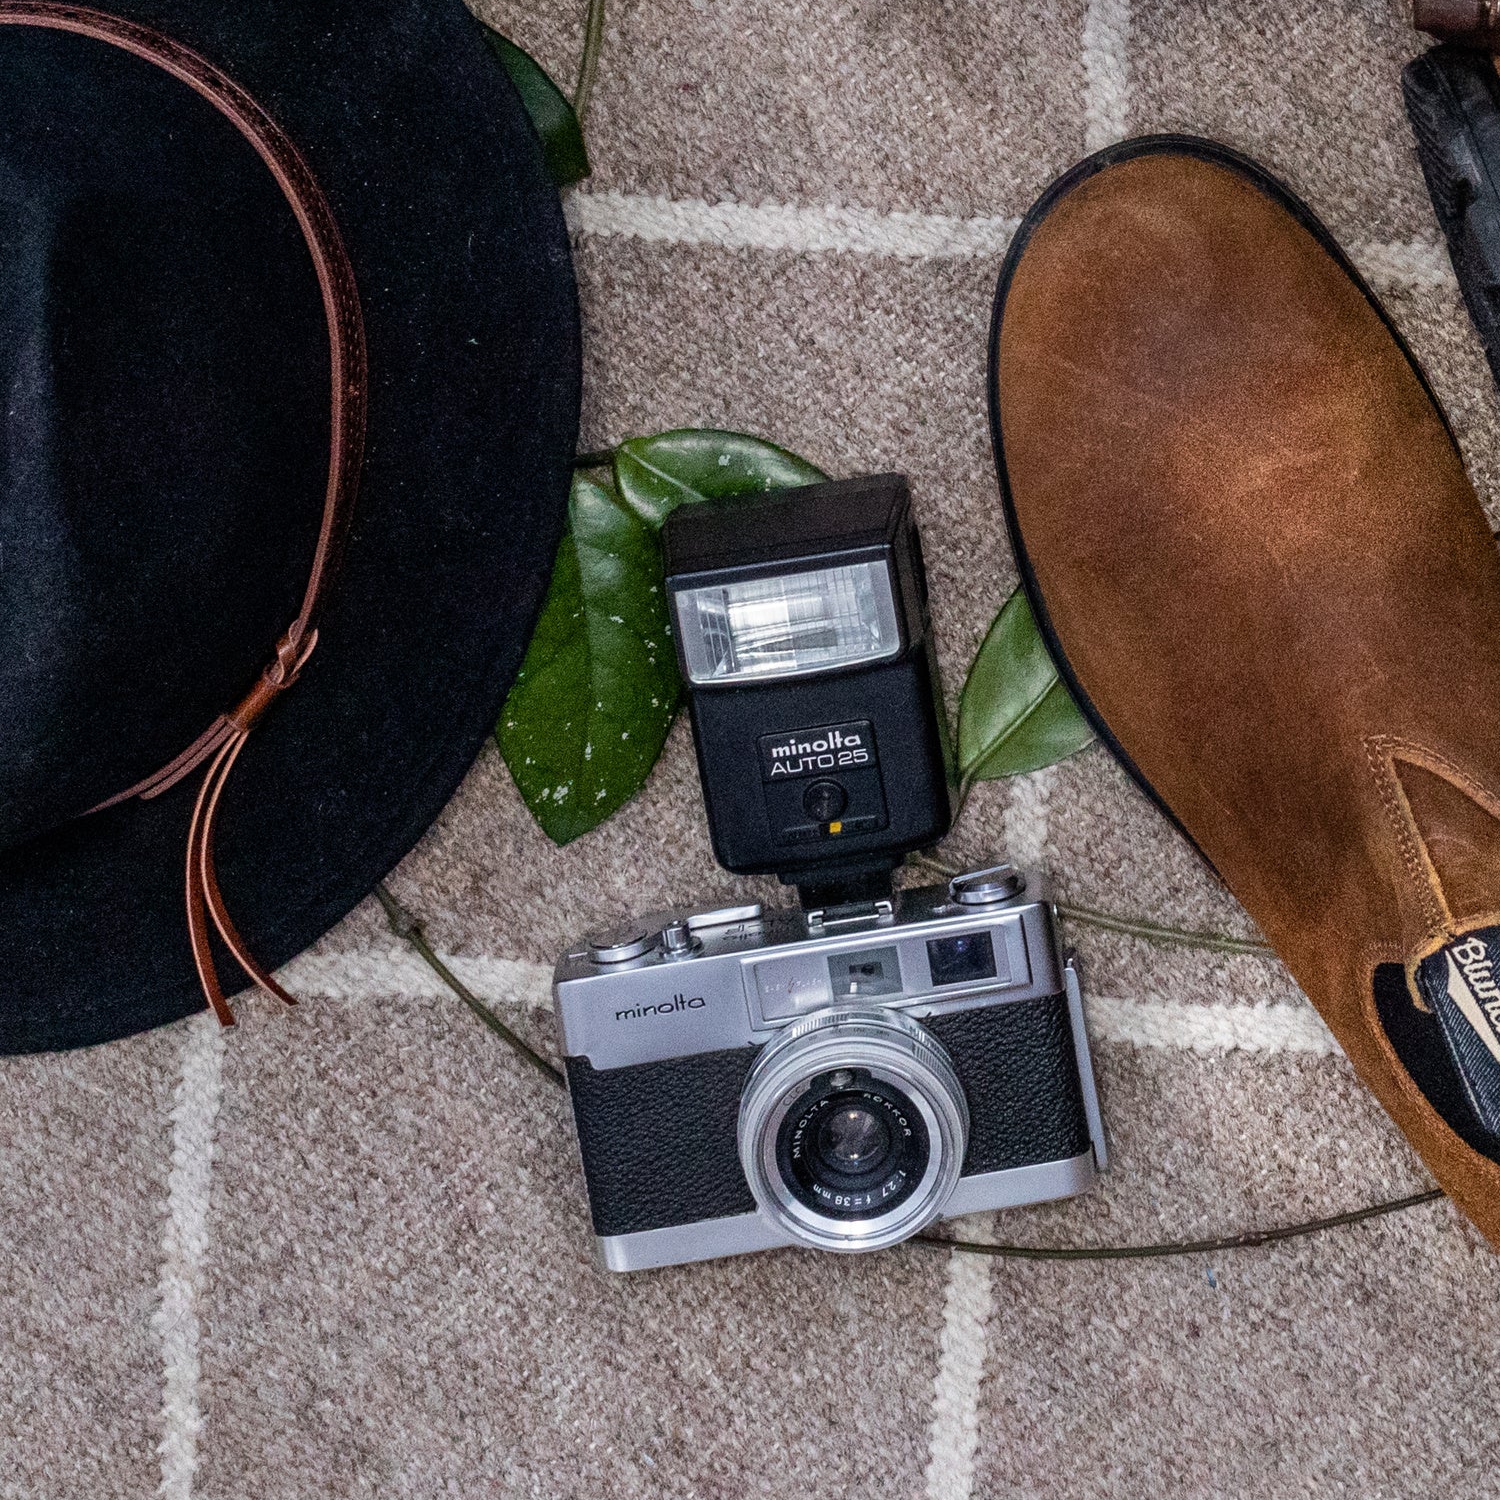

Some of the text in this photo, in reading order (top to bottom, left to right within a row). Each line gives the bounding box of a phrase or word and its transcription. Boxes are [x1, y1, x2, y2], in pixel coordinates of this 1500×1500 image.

[772, 731, 861, 758] minolta
[771, 748, 869, 776] AUTO 25
[615, 993, 706, 1020] minolta
[793, 1093, 912, 1159] MINOLTA ROKKOR
